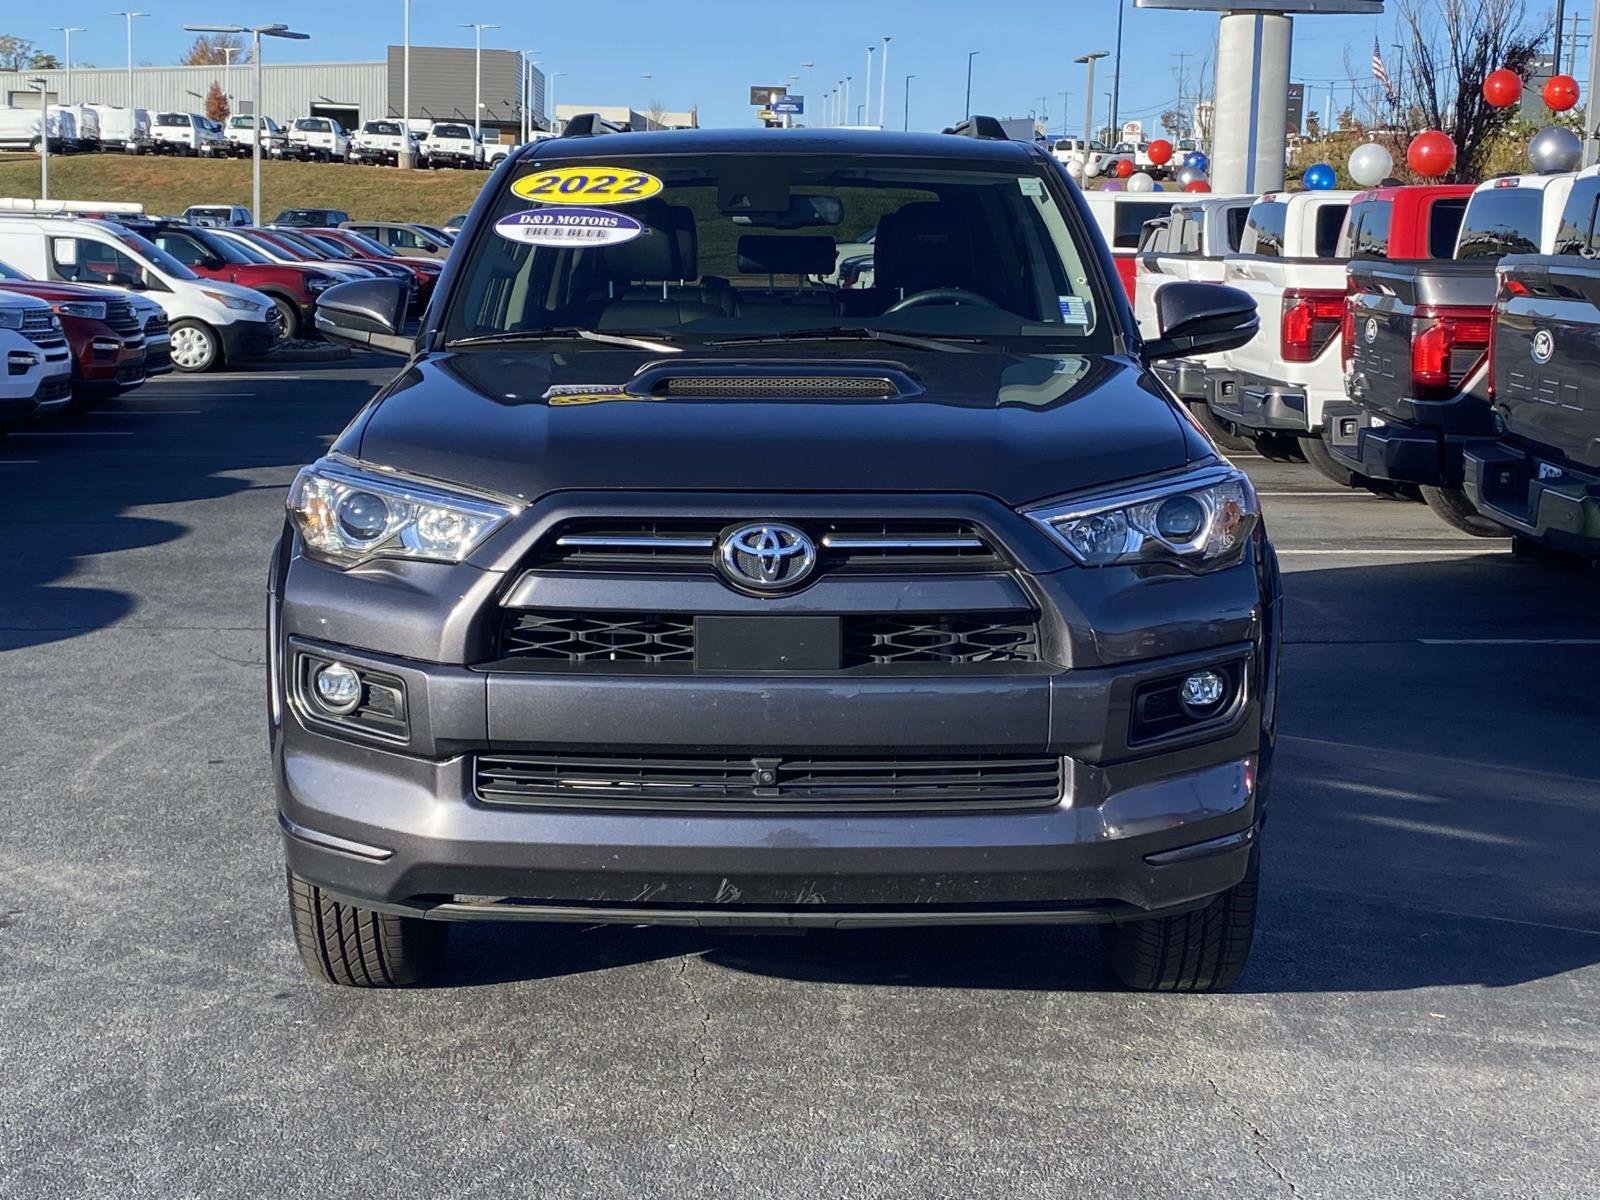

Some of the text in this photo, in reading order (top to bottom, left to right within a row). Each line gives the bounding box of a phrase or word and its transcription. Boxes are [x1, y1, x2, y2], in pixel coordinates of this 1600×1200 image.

[526, 175, 650, 195] 2022
[519, 214, 619, 227] D&D MOTORS
[525, 227, 563, 237] TRUE
[566, 228, 608, 239] BLUE
